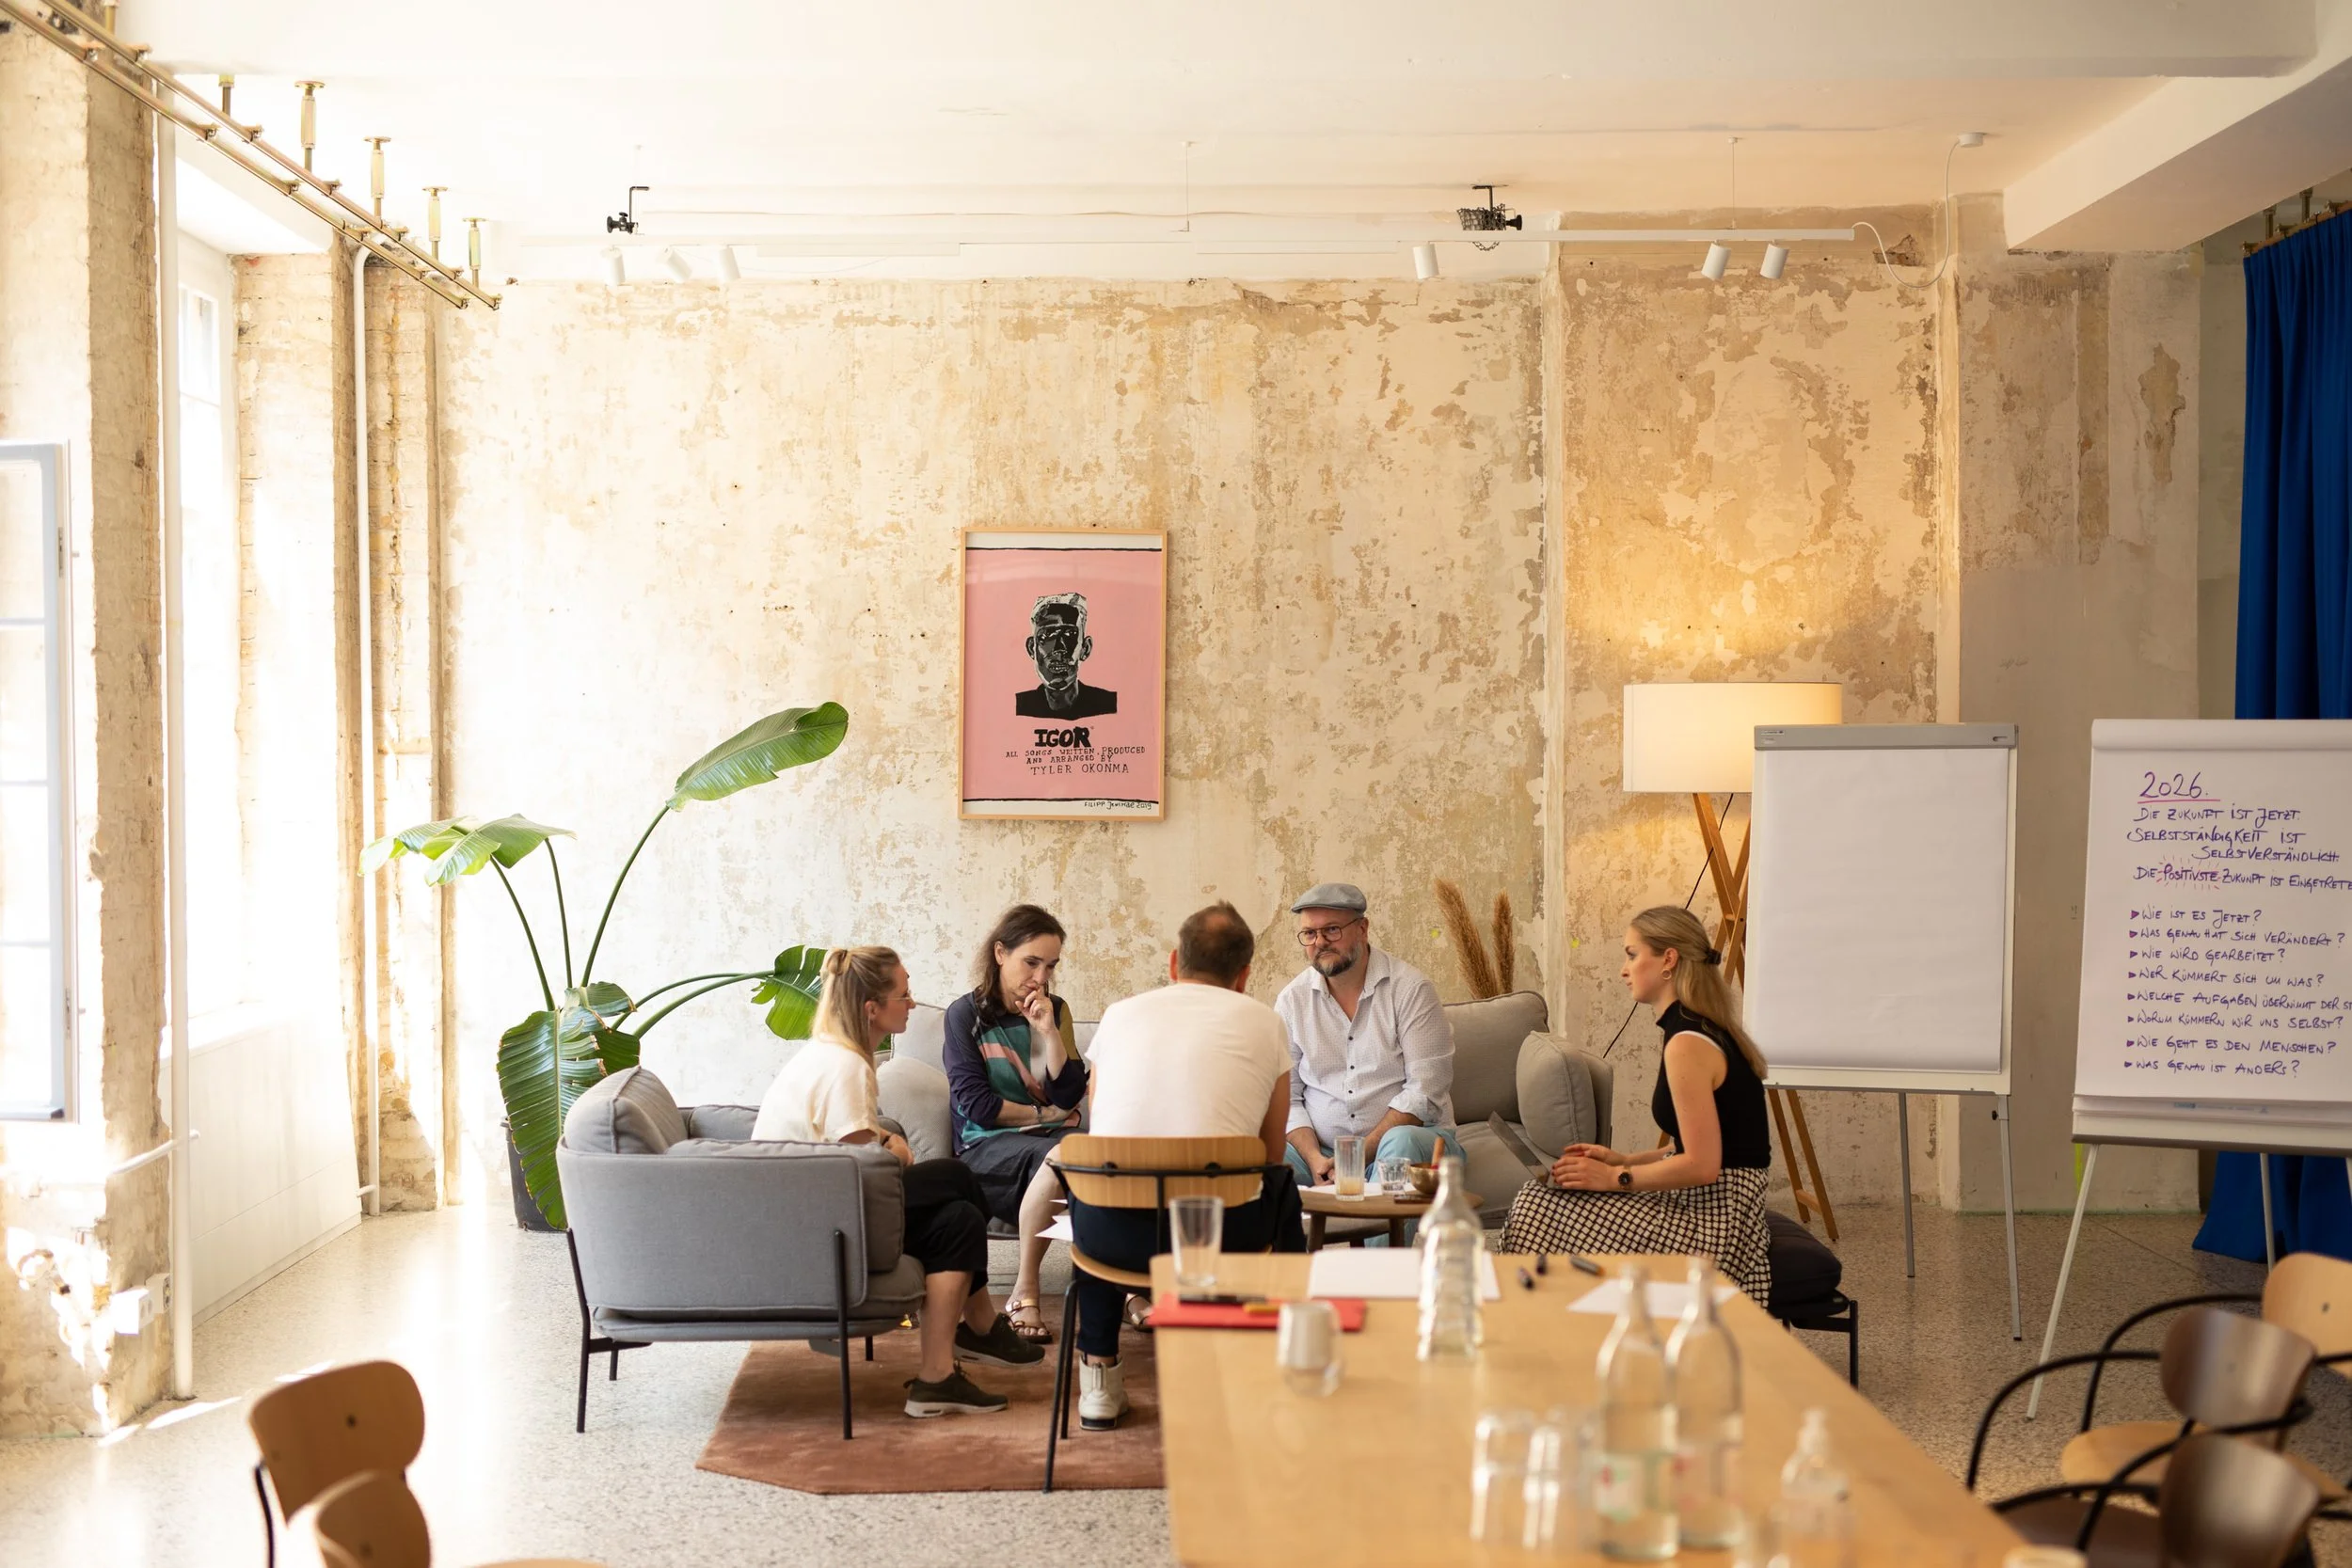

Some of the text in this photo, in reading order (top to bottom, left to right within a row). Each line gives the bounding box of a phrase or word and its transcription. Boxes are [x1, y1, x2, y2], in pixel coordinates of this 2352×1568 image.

[1034, 726, 1091, 748] IGOR
[1103, 746, 1145, 754] PRODUCED
[1051, 754, 1095, 763] ARRANGED
[1031, 764, 1129, 775] TYLER OKONMA
[2133, 808, 2160, 822] DIE
[2168, 808, 2224, 820] ZUKUNFT
[2231, 803, 2252, 820] IST
[2280, 832, 2307, 844] IST
[2134, 866, 2158, 879] DIE
[2163, 863, 2218, 881] POSITIVSTE
[2270, 876, 2284, 887] IST
[2141, 906, 2162, 920] WIE
[2170, 906, 2185, 919] IST
[2192, 911, 2206, 920] ES
[2141, 927, 2161, 939] WAS
[2167, 928, 2201, 943] GENAU
[2204, 928, 2228, 940] HAT
[2231, 931, 2256, 942] SICH
[2142, 947, 2161, 958] WIE
[2170, 947, 2199, 960] WIRD
[2139, 965, 2168, 979] WER
[2172, 968, 2227, 982] KÜMMERT
[2233, 972, 2256, 984] SICH
[2137, 992, 2185, 1003] WELCHE
[2193, 992, 2257, 1009] AUFGABEN
[2321, 998, 2340, 1010] DER
[2137, 1010, 2172, 1023] WORUM
[2178, 1013, 2225, 1026] KÜMMERN
[2232, 1016, 2253, 1028] WIR
[2260, 1019, 2279, 1029] UNS
[2137, 1036, 2158, 1048] WIE
[2167, 1036, 2199, 1053] GEHT
[2206, 1039, 2218, 1049] ES
[2224, 1041, 2250, 1051] DEN
[2136, 1060, 2159, 1069] WAS
[2168, 1060, 2205, 1075] GENAU
[2210, 1060, 2226, 1072] IST
